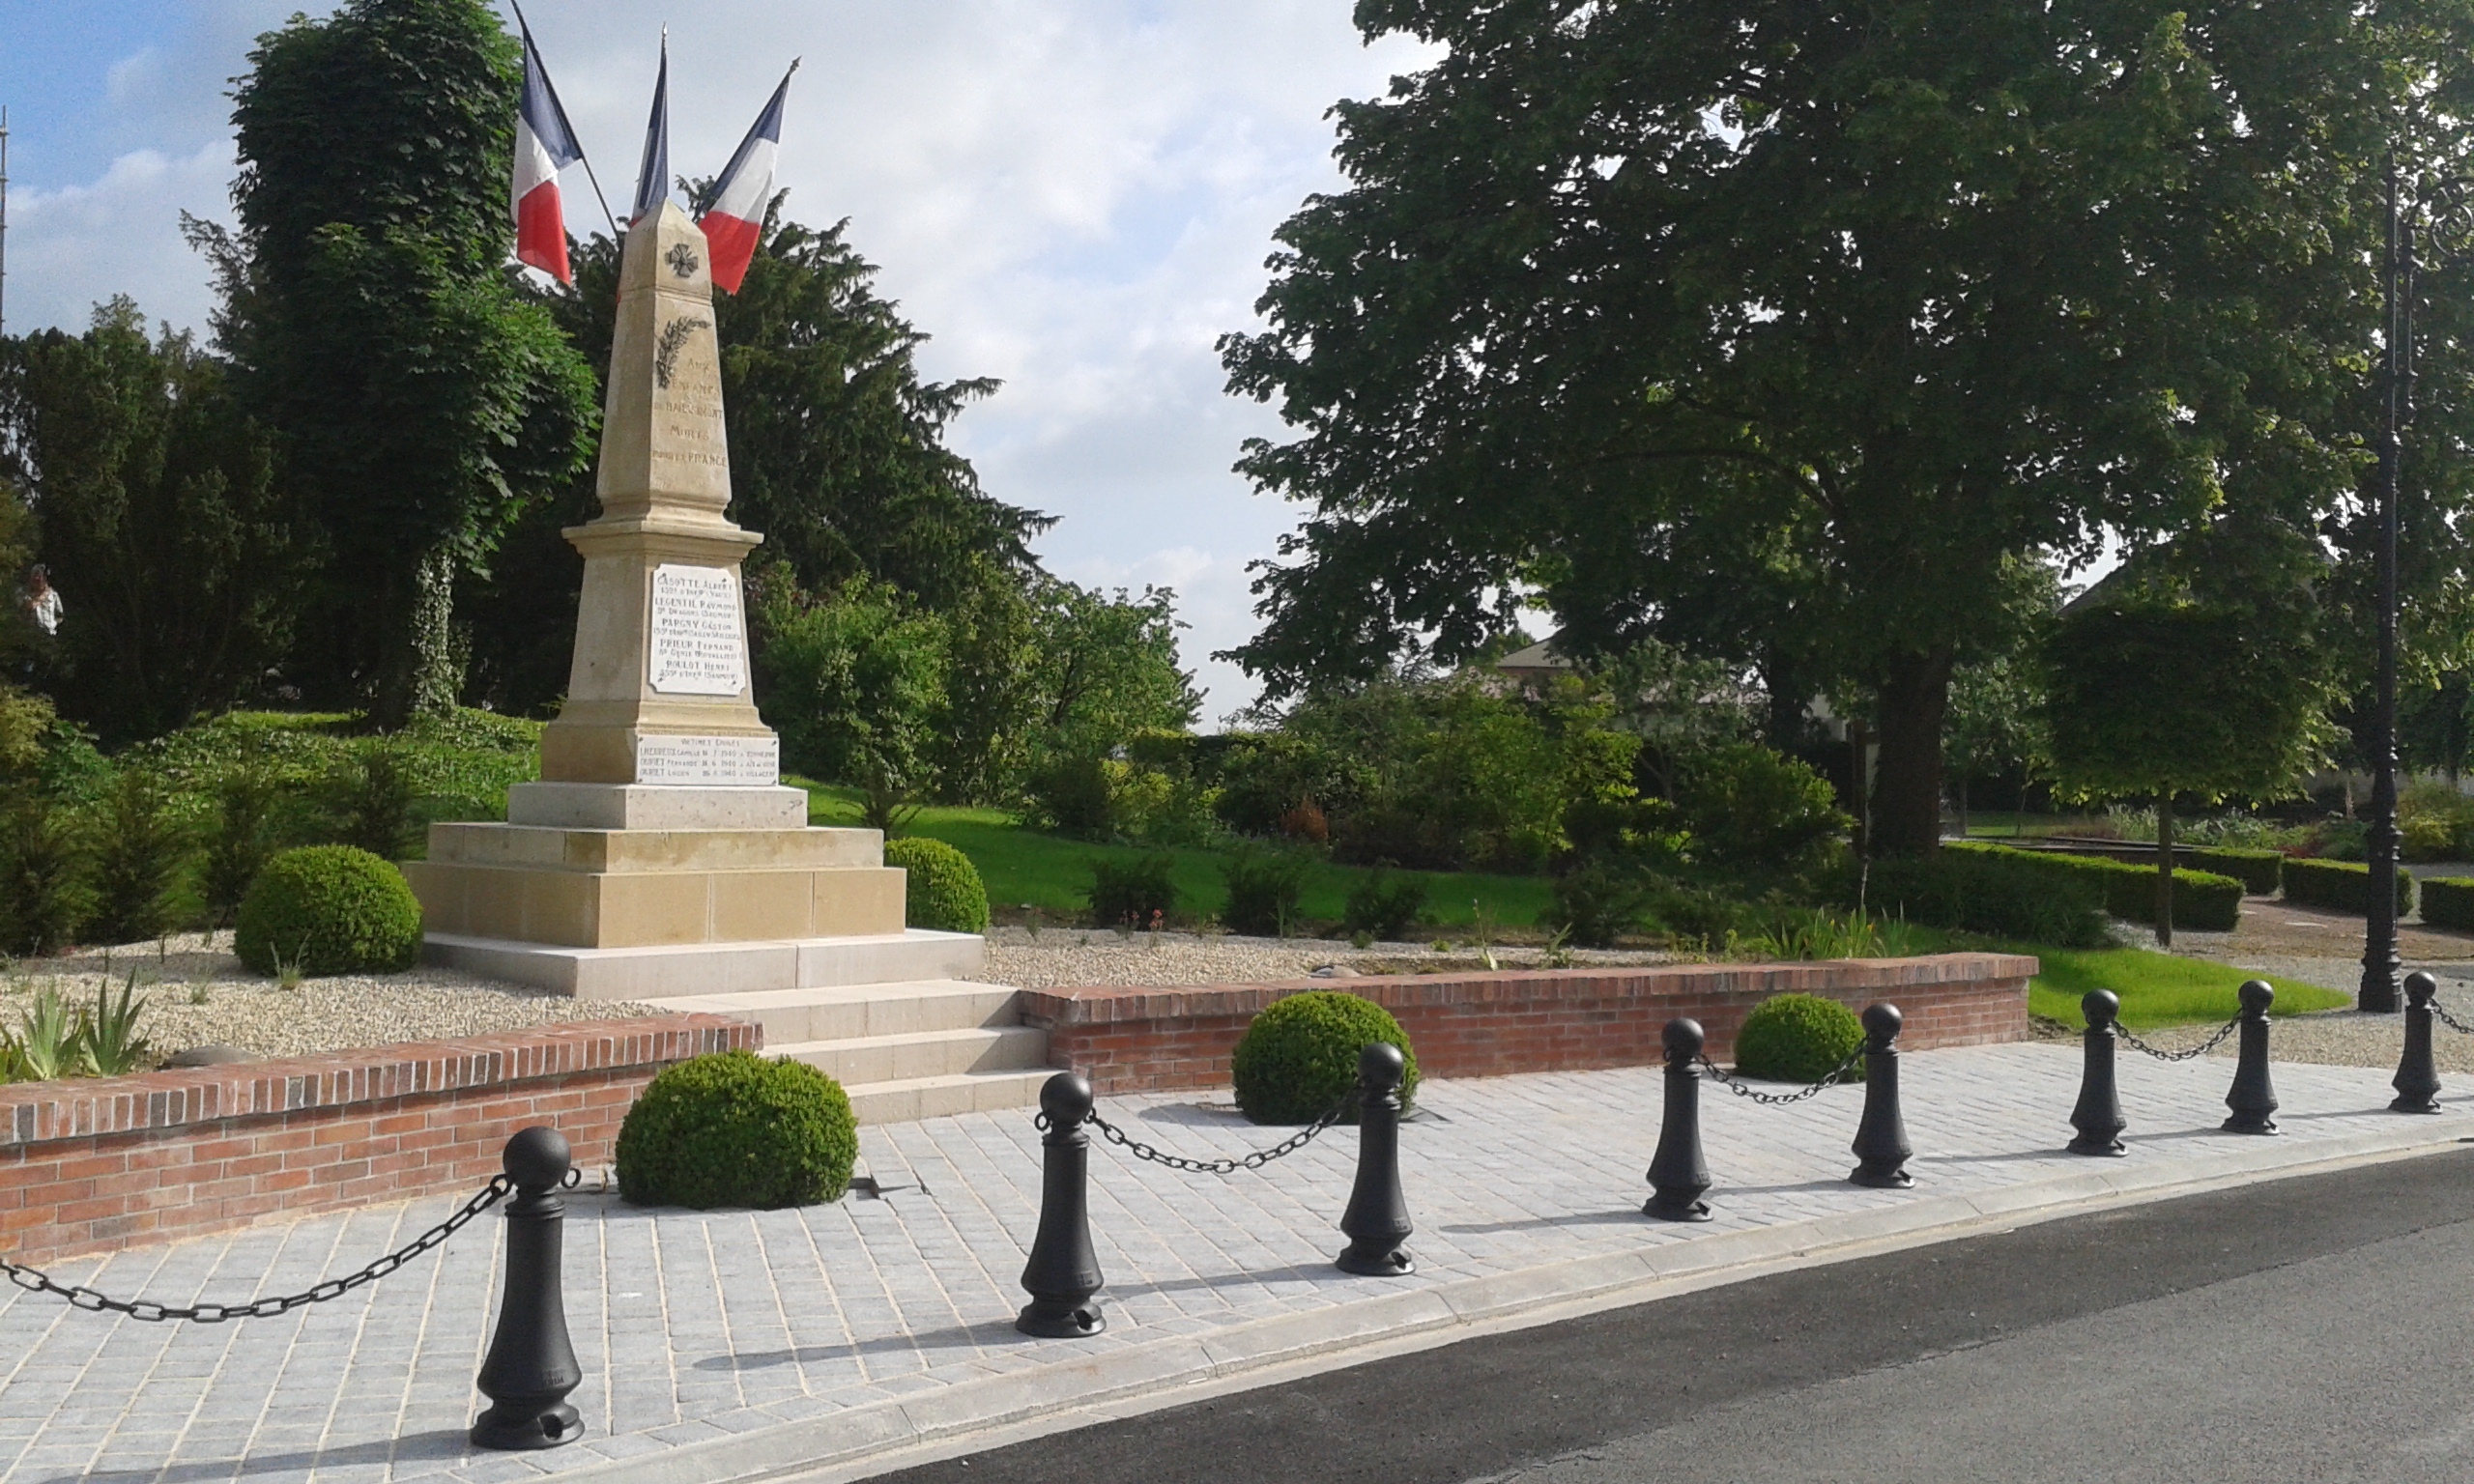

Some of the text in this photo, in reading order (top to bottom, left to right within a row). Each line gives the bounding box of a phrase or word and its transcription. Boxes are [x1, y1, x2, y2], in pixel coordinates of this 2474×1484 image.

[688, 452, 728, 468] FRANCE
[655, 597, 736, 611] LEGENTIL RAYMOND
[702, 621, 732, 631] GASTON
[660, 639, 734, 651] PRIEUR FERNAND
[704, 662, 730, 671] HENRI
[680, 737, 710, 747] VICTIMES
